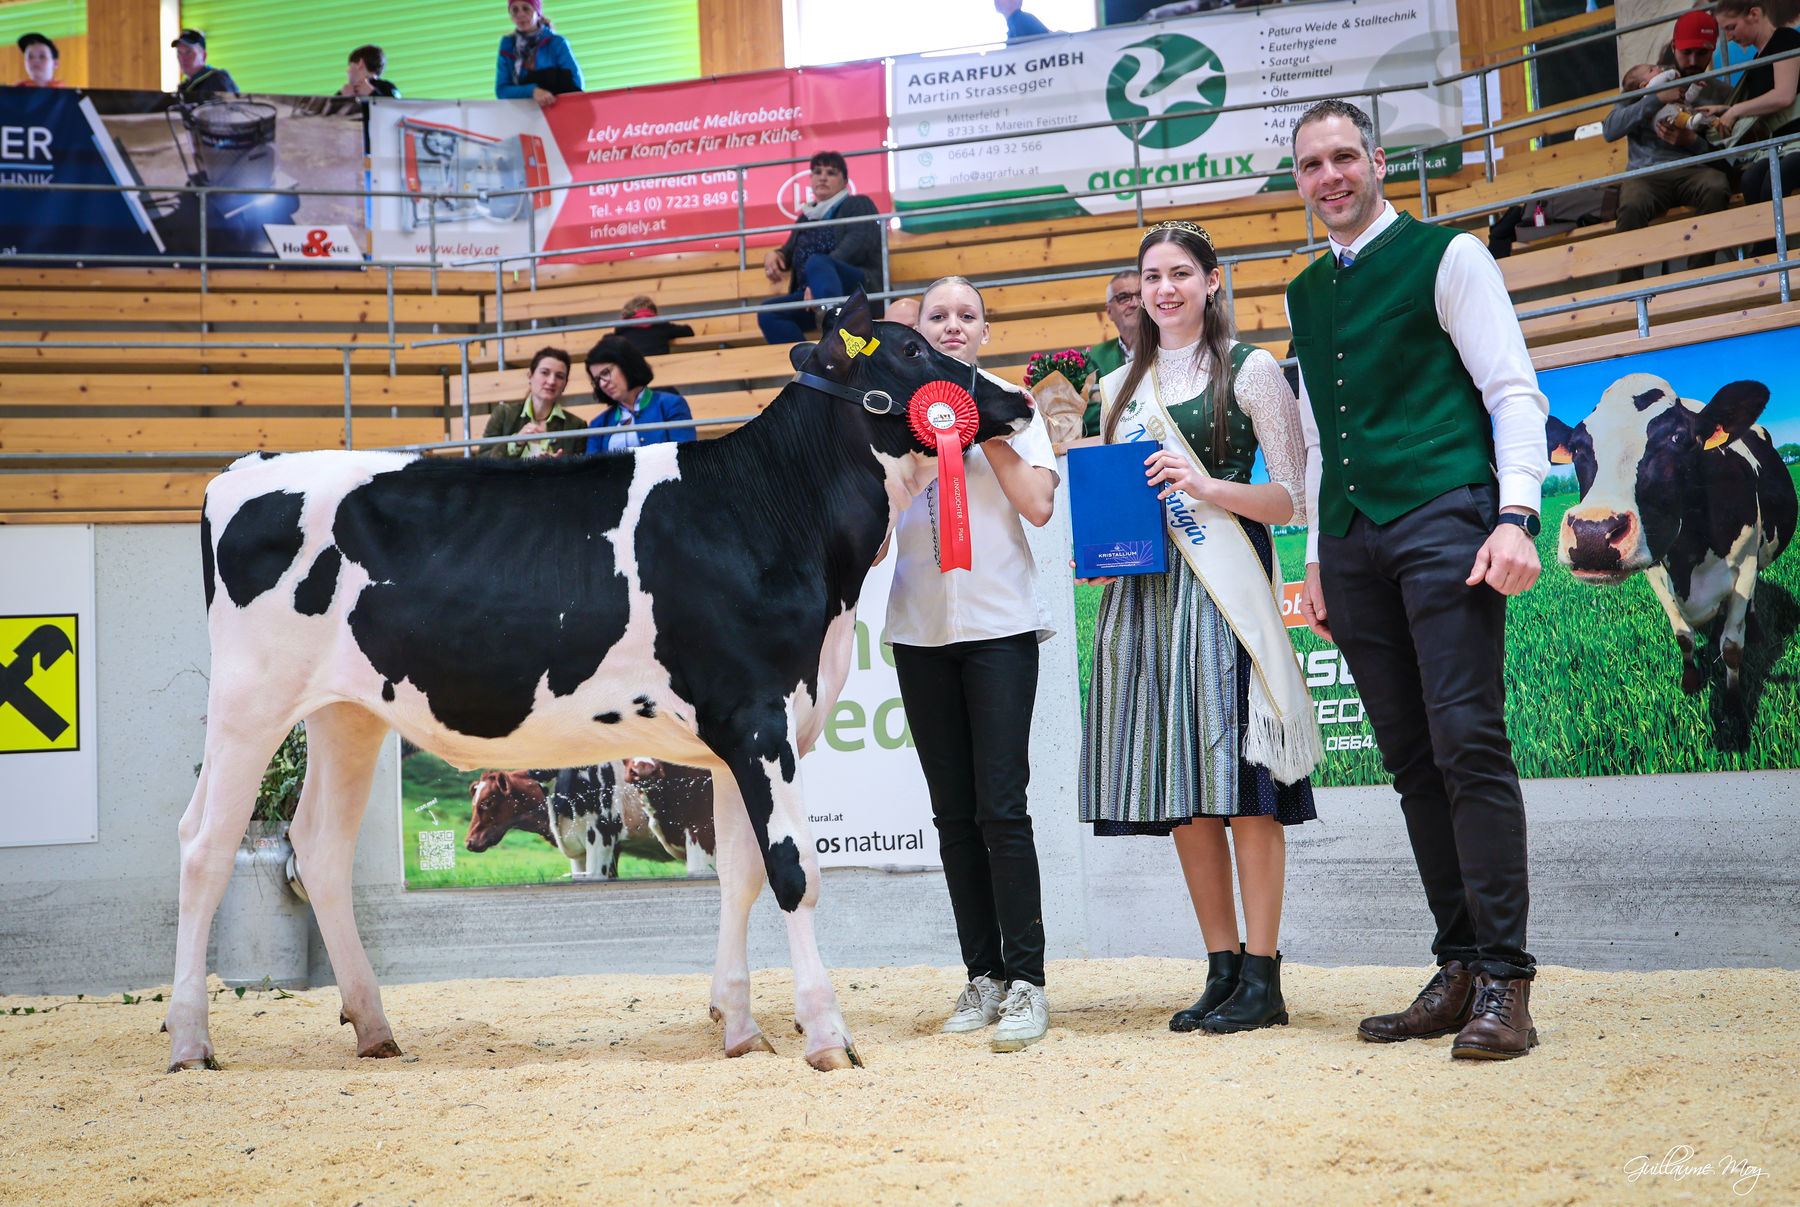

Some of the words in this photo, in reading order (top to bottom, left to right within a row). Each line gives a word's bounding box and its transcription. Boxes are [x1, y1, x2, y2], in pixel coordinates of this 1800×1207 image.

[1268, 27, 1302, 38] Patura
[1305, 20, 1338, 32] Weide
[1342, 19, 1351, 29] &
[1354, 10, 1417, 28] Stalltechnik
[1269, 38, 1337, 52] Euterhygiene
[908, 62, 1017, 87] AGRARFUX
[1025, 51, 1084, 73] GMBH
[1269, 54, 1310, 67] Saatgut
[1269, 65, 1333, 82] Futtermittel
[908, 90, 960, 105] Martin
[965, 76, 1055, 99] Strassegger
[1271, 85, 1289, 98] Öle
[947, 109, 1000, 123] Mitterfeld
[1271, 101, 1320, 113] Schmier
[587, 125, 620, 143] Lely
[623, 116, 700, 138] Astronaut
[704, 106, 803, 129] Melkroboter.
[948, 125, 975, 137] 8733
[996, 121, 1033, 131] Marein
[587, 147, 627, 164] Mehr
[630, 139, 693, 160] Komfort
[696, 135, 721, 155] für
[725, 131, 756, 149] Ihre
[760, 127, 802, 144] Kühe.
[1272, 134, 1293, 146] Agr
[948, 149, 975, 160] 0664
[986, 145, 1000, 155] 49
[1003, 143, 1017, 153] 32
[1021, 141, 1042, 152] 566
[950, 165, 1039, 184] info@agrarfux.at
[1088, 153, 1254, 200] agrarfux
[588, 183, 619, 198] Lely
[589, 203, 612, 218] Tel.
[643, 196, 662, 212] (0)
[666, 194, 700, 209] 7223
[703, 191, 728, 206] 849
[590, 218, 667, 239] info@lely.at
